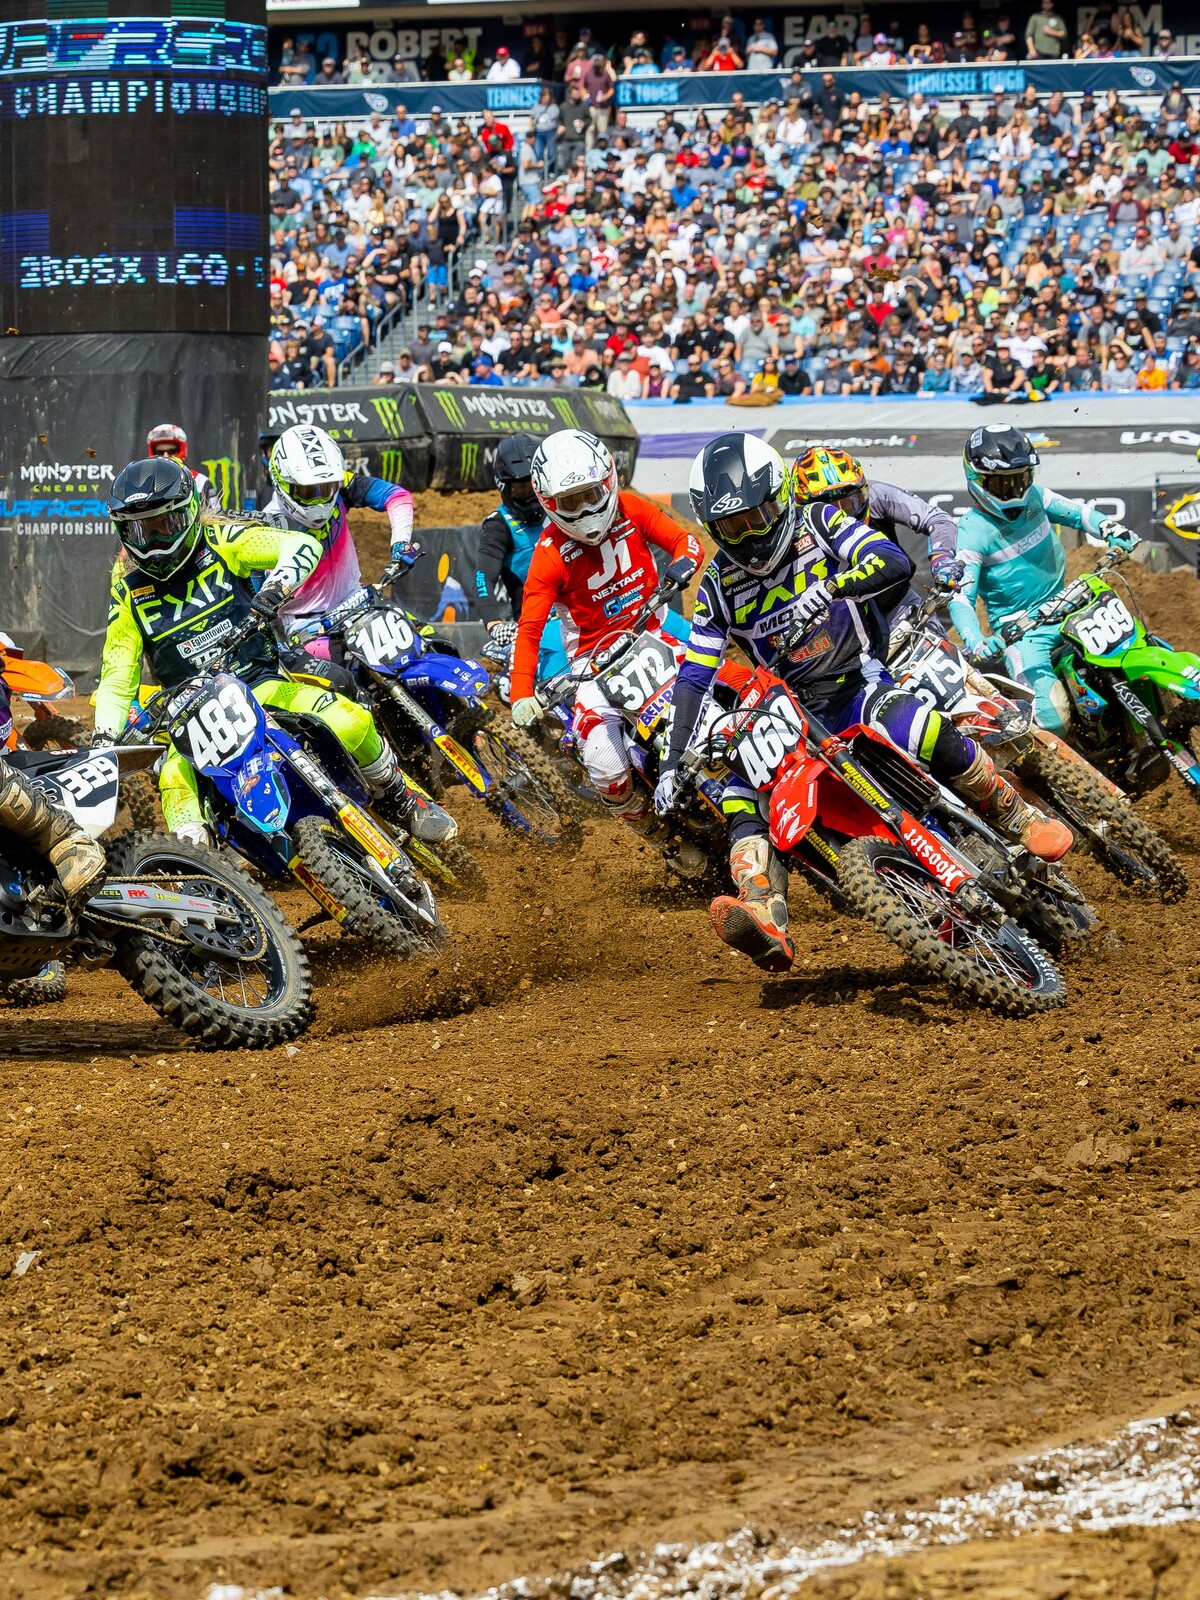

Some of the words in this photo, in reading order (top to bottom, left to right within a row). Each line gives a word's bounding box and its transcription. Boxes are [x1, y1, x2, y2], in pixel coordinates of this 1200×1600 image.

[981, 69, 1026, 92] TOUGH
[268, 400, 369, 427] NSTER
[462, 391, 557, 420] MONSTER
[488, 419, 551, 433] ENERGY
[20, 462, 117, 484] MONSTER
[33, 484, 100, 493] ENERGY
[16, 522, 116, 536] CHAMPIONSHI
[135, 561, 233, 636] FXR
[591, 567, 646, 602] NEXTAFF
[731, 577, 759, 593] HONDA
[734, 549, 828, 625] FXR
[191, 620, 231, 647] Eglentowicz
[355, 607, 414, 667] 146
[1077, 597, 1135, 656] 689
[606, 647, 676, 711] 372
[186, 684, 258, 772] 483
[736, 694, 803, 788] 460
[55, 755, 119, 801] 339
[1163, 748, 1197, 785] DUNLOP
[904, 828, 965, 890] Hoosier
[97, 889, 121, 897] XCEL
[127, 889, 150, 899] RK
